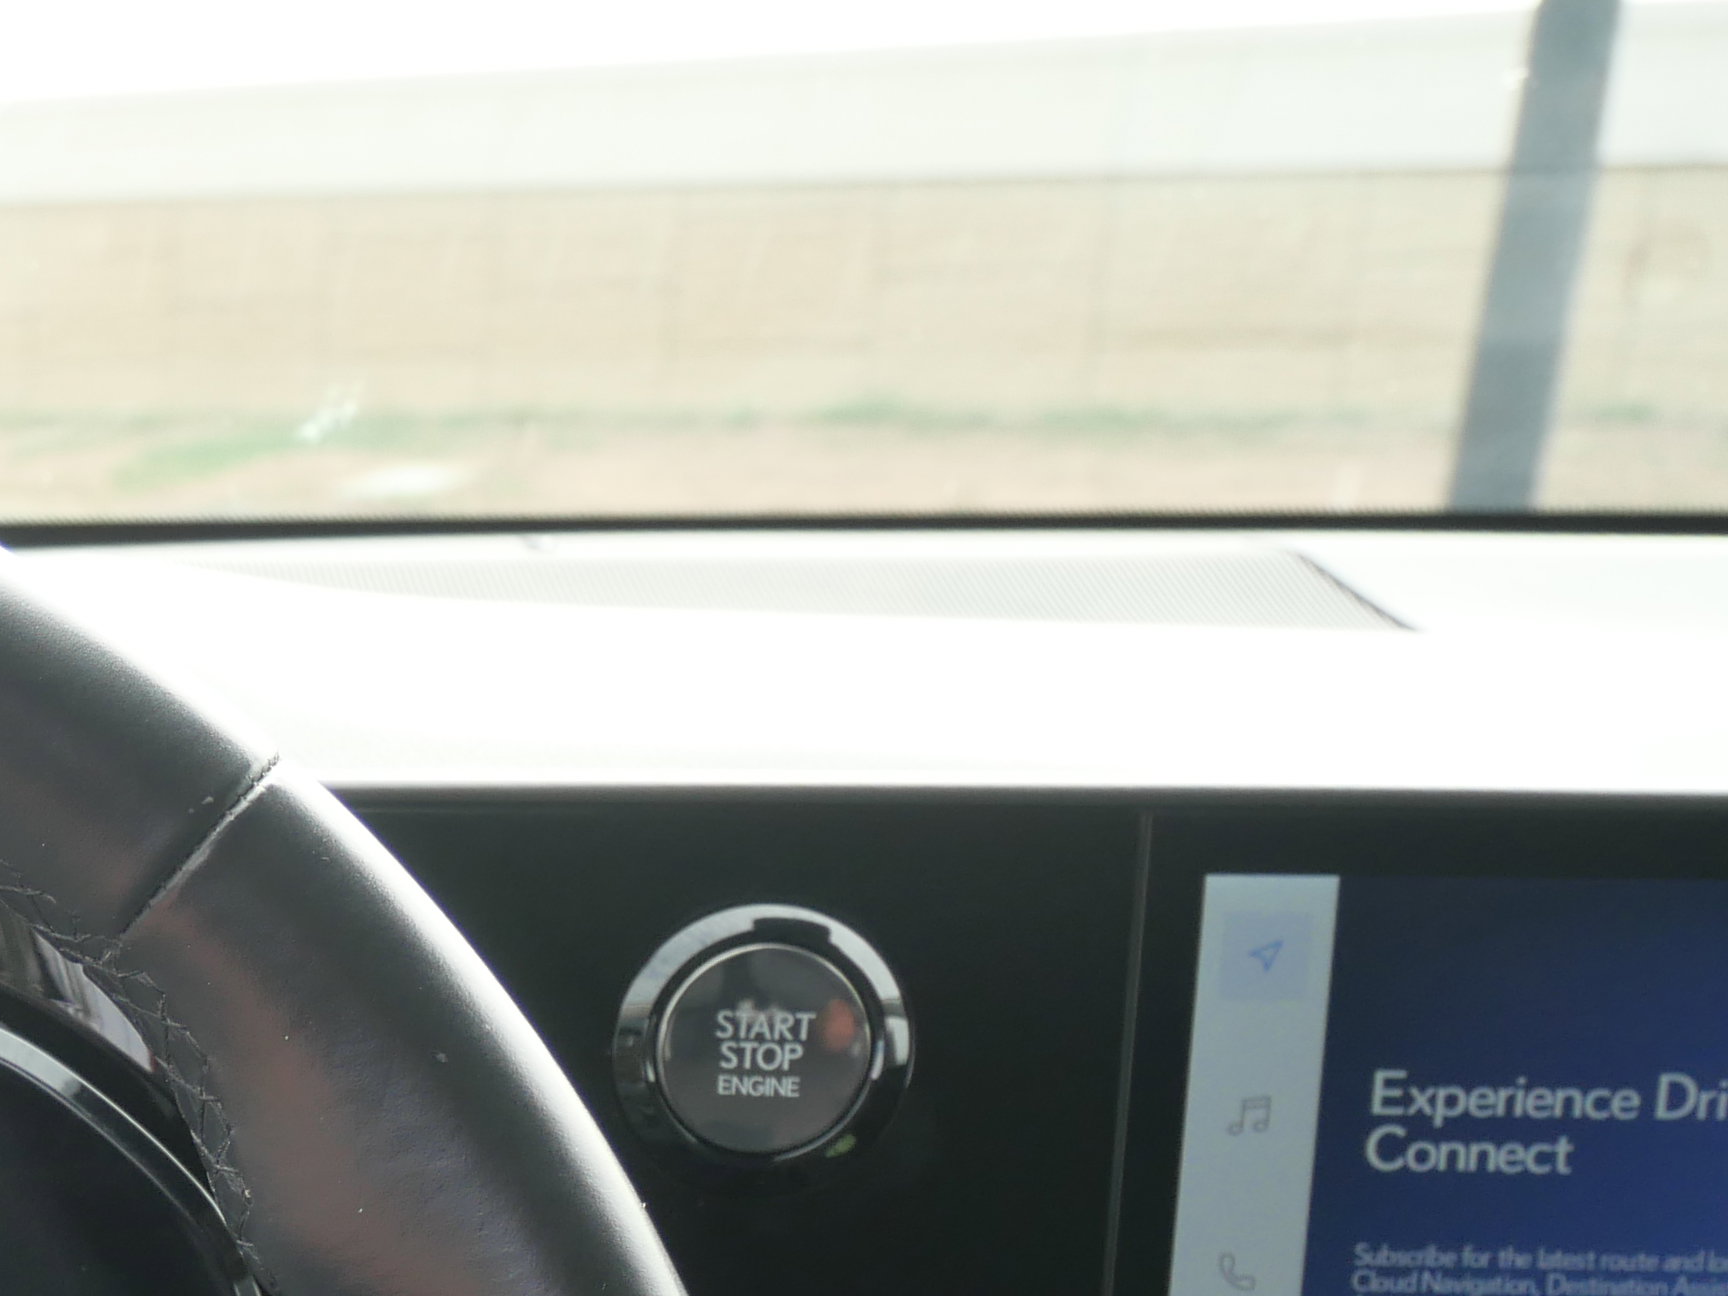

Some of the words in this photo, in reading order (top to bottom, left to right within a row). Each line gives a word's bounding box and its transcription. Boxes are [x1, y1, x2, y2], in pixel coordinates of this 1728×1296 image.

[715, 1009, 817, 1042] START
[719, 1041, 804, 1072] STOP
[717, 1075, 801, 1098] ENGINE
[1371, 1069, 1642, 1128] Experience
[1365, 1124, 1575, 1176] Connect
